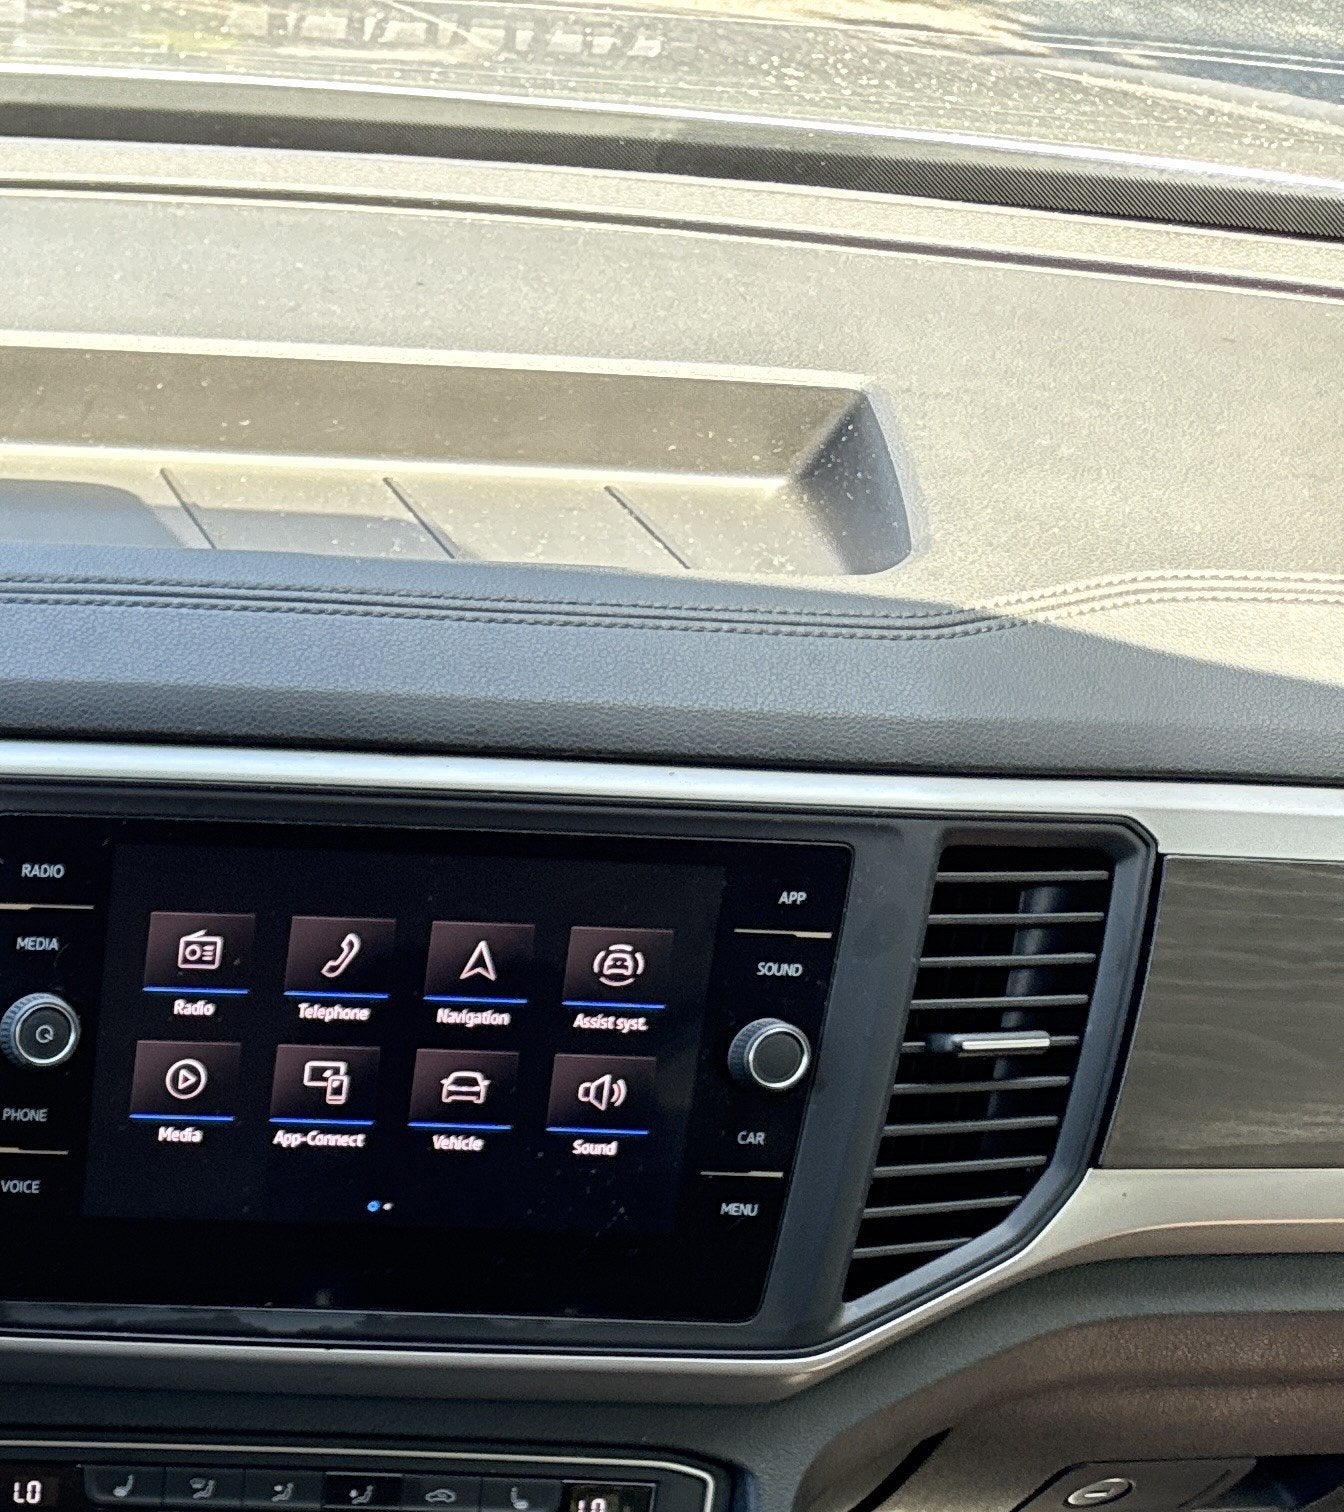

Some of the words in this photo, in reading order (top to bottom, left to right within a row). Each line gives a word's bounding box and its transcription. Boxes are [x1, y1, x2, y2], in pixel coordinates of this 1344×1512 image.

[21, 864, 65, 878] RADIO
[778, 890, 807, 905] APP
[16, 937, 59, 951] MEDIA
[757, 962, 803, 978] SOUND
[173, 999, 215, 1016] Radio
[298, 1003, 371, 1021] Telephone
[437, 1009, 510, 1027] Navigation
[573, 1013, 615, 1030] Assist
[616, 1016, 648, 1033] syst.
[2, 1108, 48, 1122] PHONE
[158, 1127, 203, 1143] Media
[273, 1131, 365, 1148] App-Connect
[737, 1131, 765, 1145] CAR
[433, 1136, 484, 1152] Vehicle
[572, 1140, 619, 1156] Sound
[0, 1180, 40, 1194] VOICE
[720, 1202, 759, 1217] MENU
[13, 1480, 42, 1504] LO
